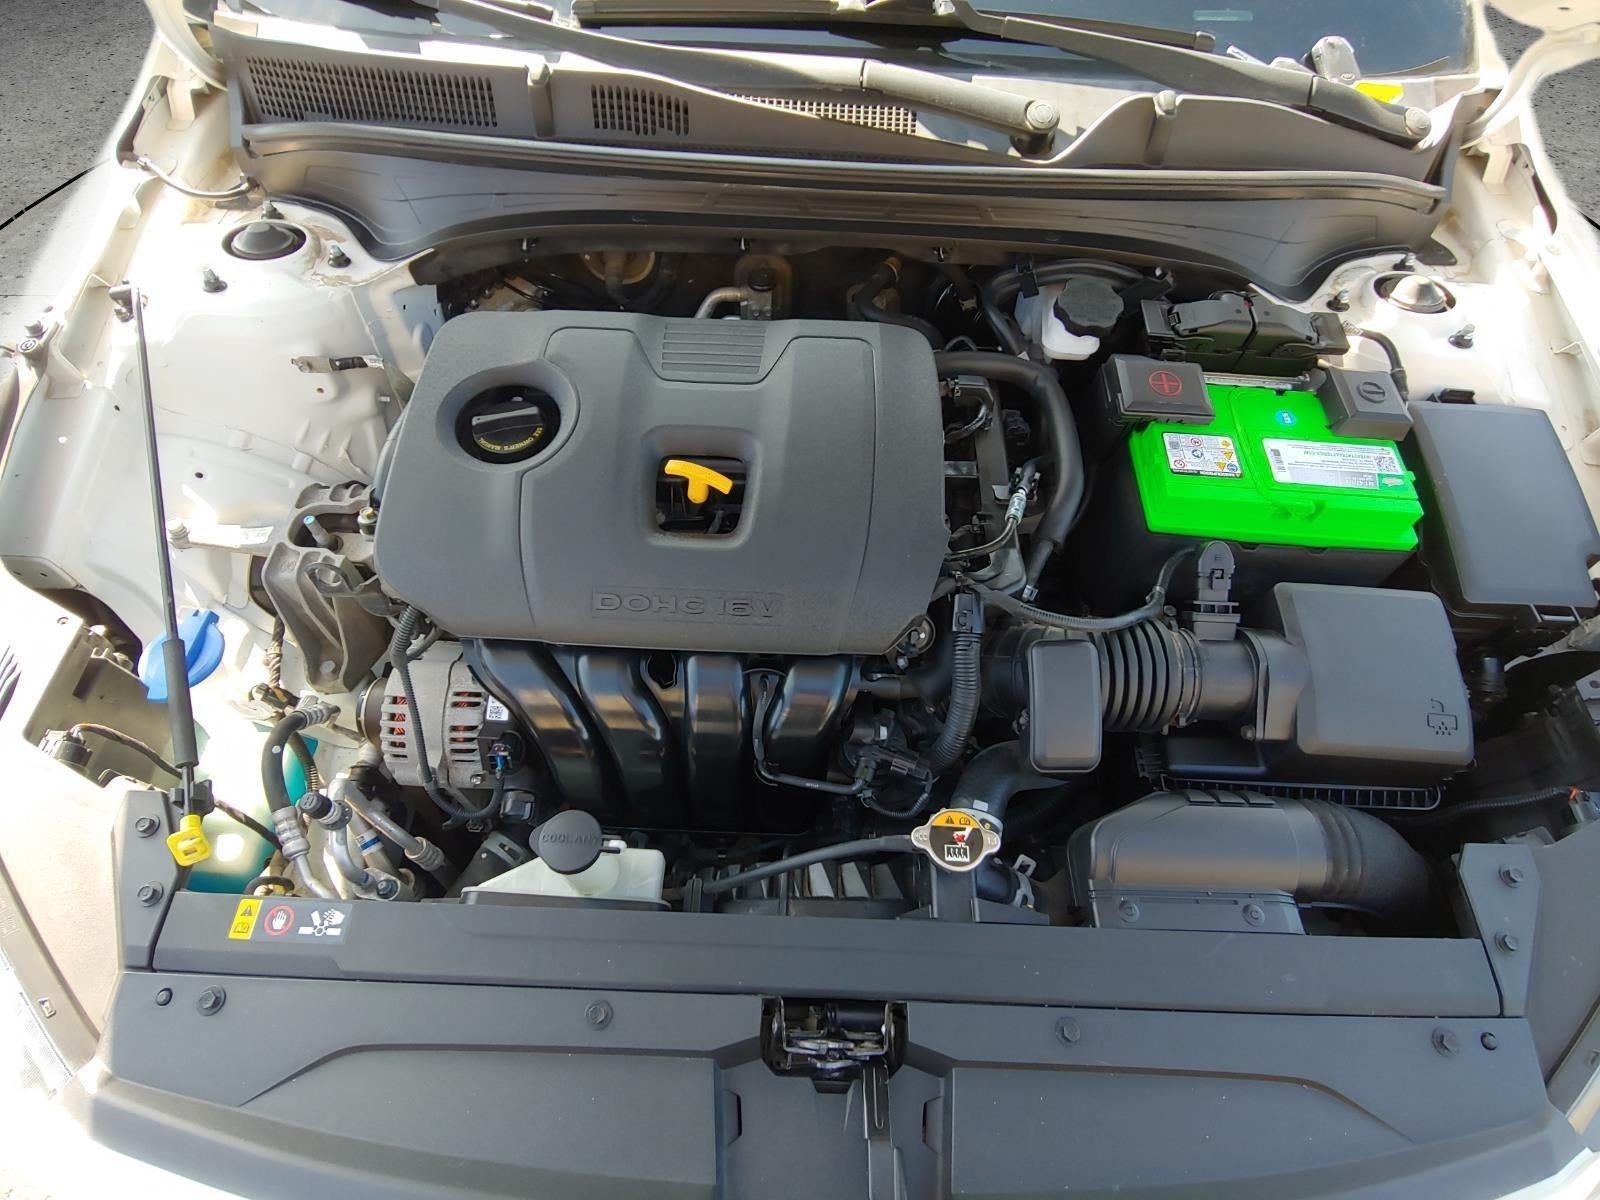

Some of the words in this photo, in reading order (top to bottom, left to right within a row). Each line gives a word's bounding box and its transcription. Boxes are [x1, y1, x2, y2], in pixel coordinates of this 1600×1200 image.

[479, 437, 501, 451] MANUAL
[503, 437, 534, 451] OWNER'S
[594, 592, 706, 616] DOHC
[717, 596, 779, 618] 16V
[542, 832, 597, 845] COOLAN
